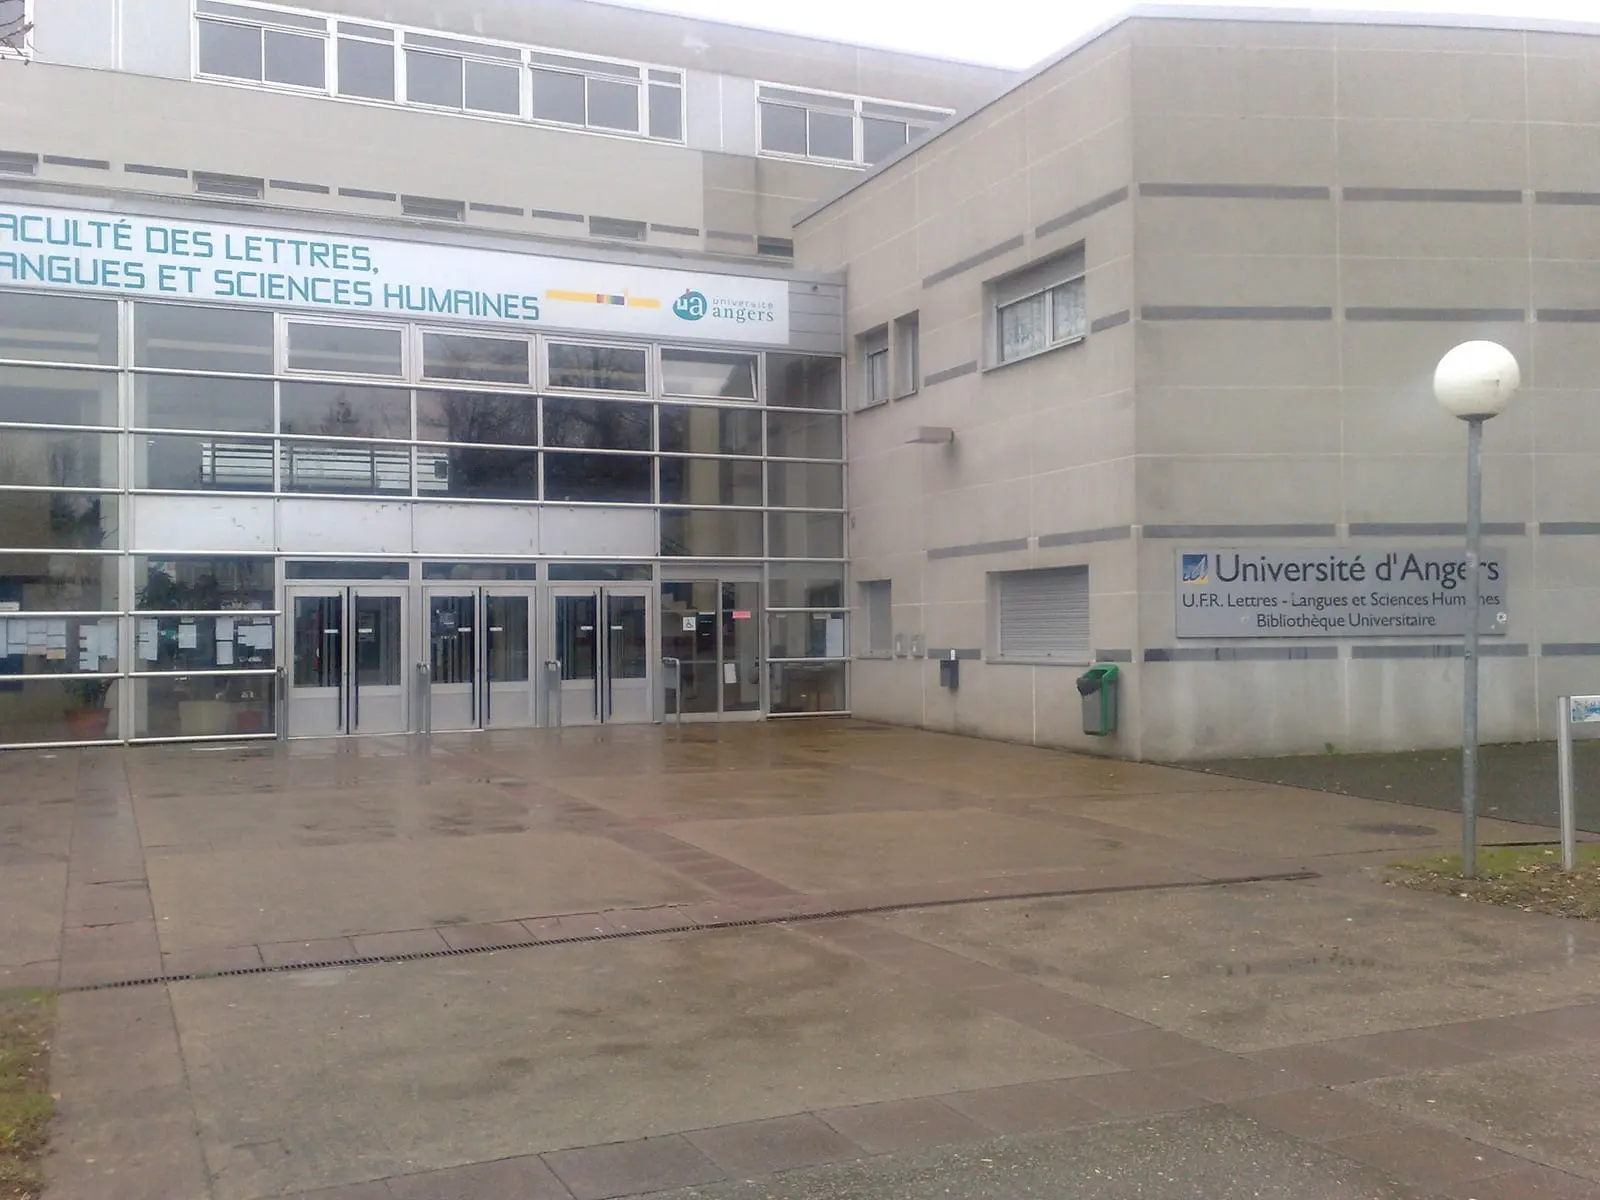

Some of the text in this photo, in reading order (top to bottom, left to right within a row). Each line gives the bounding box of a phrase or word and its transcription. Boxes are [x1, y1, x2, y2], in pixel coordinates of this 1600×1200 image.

[145, 226, 213, 259] DES
[224, 233, 379, 275] LETTRES,
[158, 264, 201, 293] ET
[214, 269, 372, 307] SCIENCES
[384, 283, 540, 321] HUMAINES
[712, 306, 775, 324] angers
[1216, 553, 1366, 583] Université
[1182, 593, 1224, 608] U.F.R.
[1227, 593, 1278, 608] Lettres
[1291, 592, 1349, 611] Langues
[1351, 596, 1367, 607] et
[1370, 591, 1429, 607] Sciences
[1432, 591, 1501, 606] Humnes
[1256, 612, 1437, 632] Bibliothèque Universitaire
